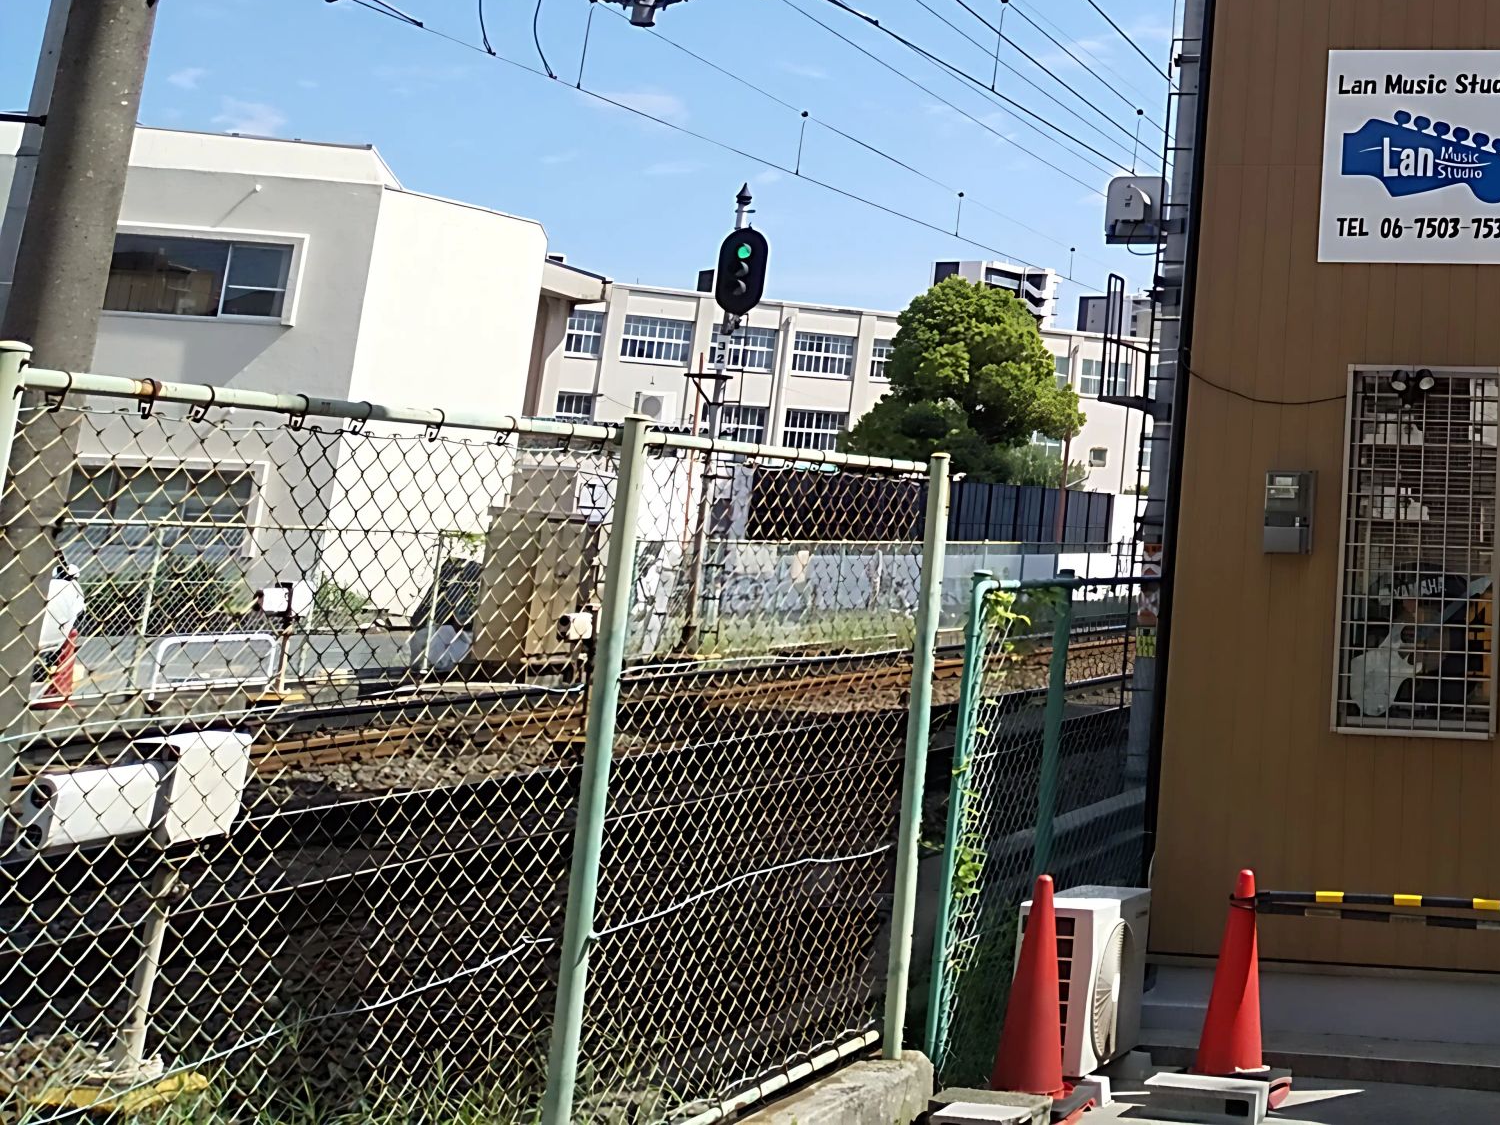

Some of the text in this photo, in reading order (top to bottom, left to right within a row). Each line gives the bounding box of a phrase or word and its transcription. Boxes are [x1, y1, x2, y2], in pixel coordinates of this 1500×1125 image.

[1338, 75, 1377, 95] Lan
[1385, 74, 1447, 95] Music
[1383, 137, 1434, 178] Lan
[1440, 146, 1480, 164] Music
[1336, 217, 1369, 237] TEL
